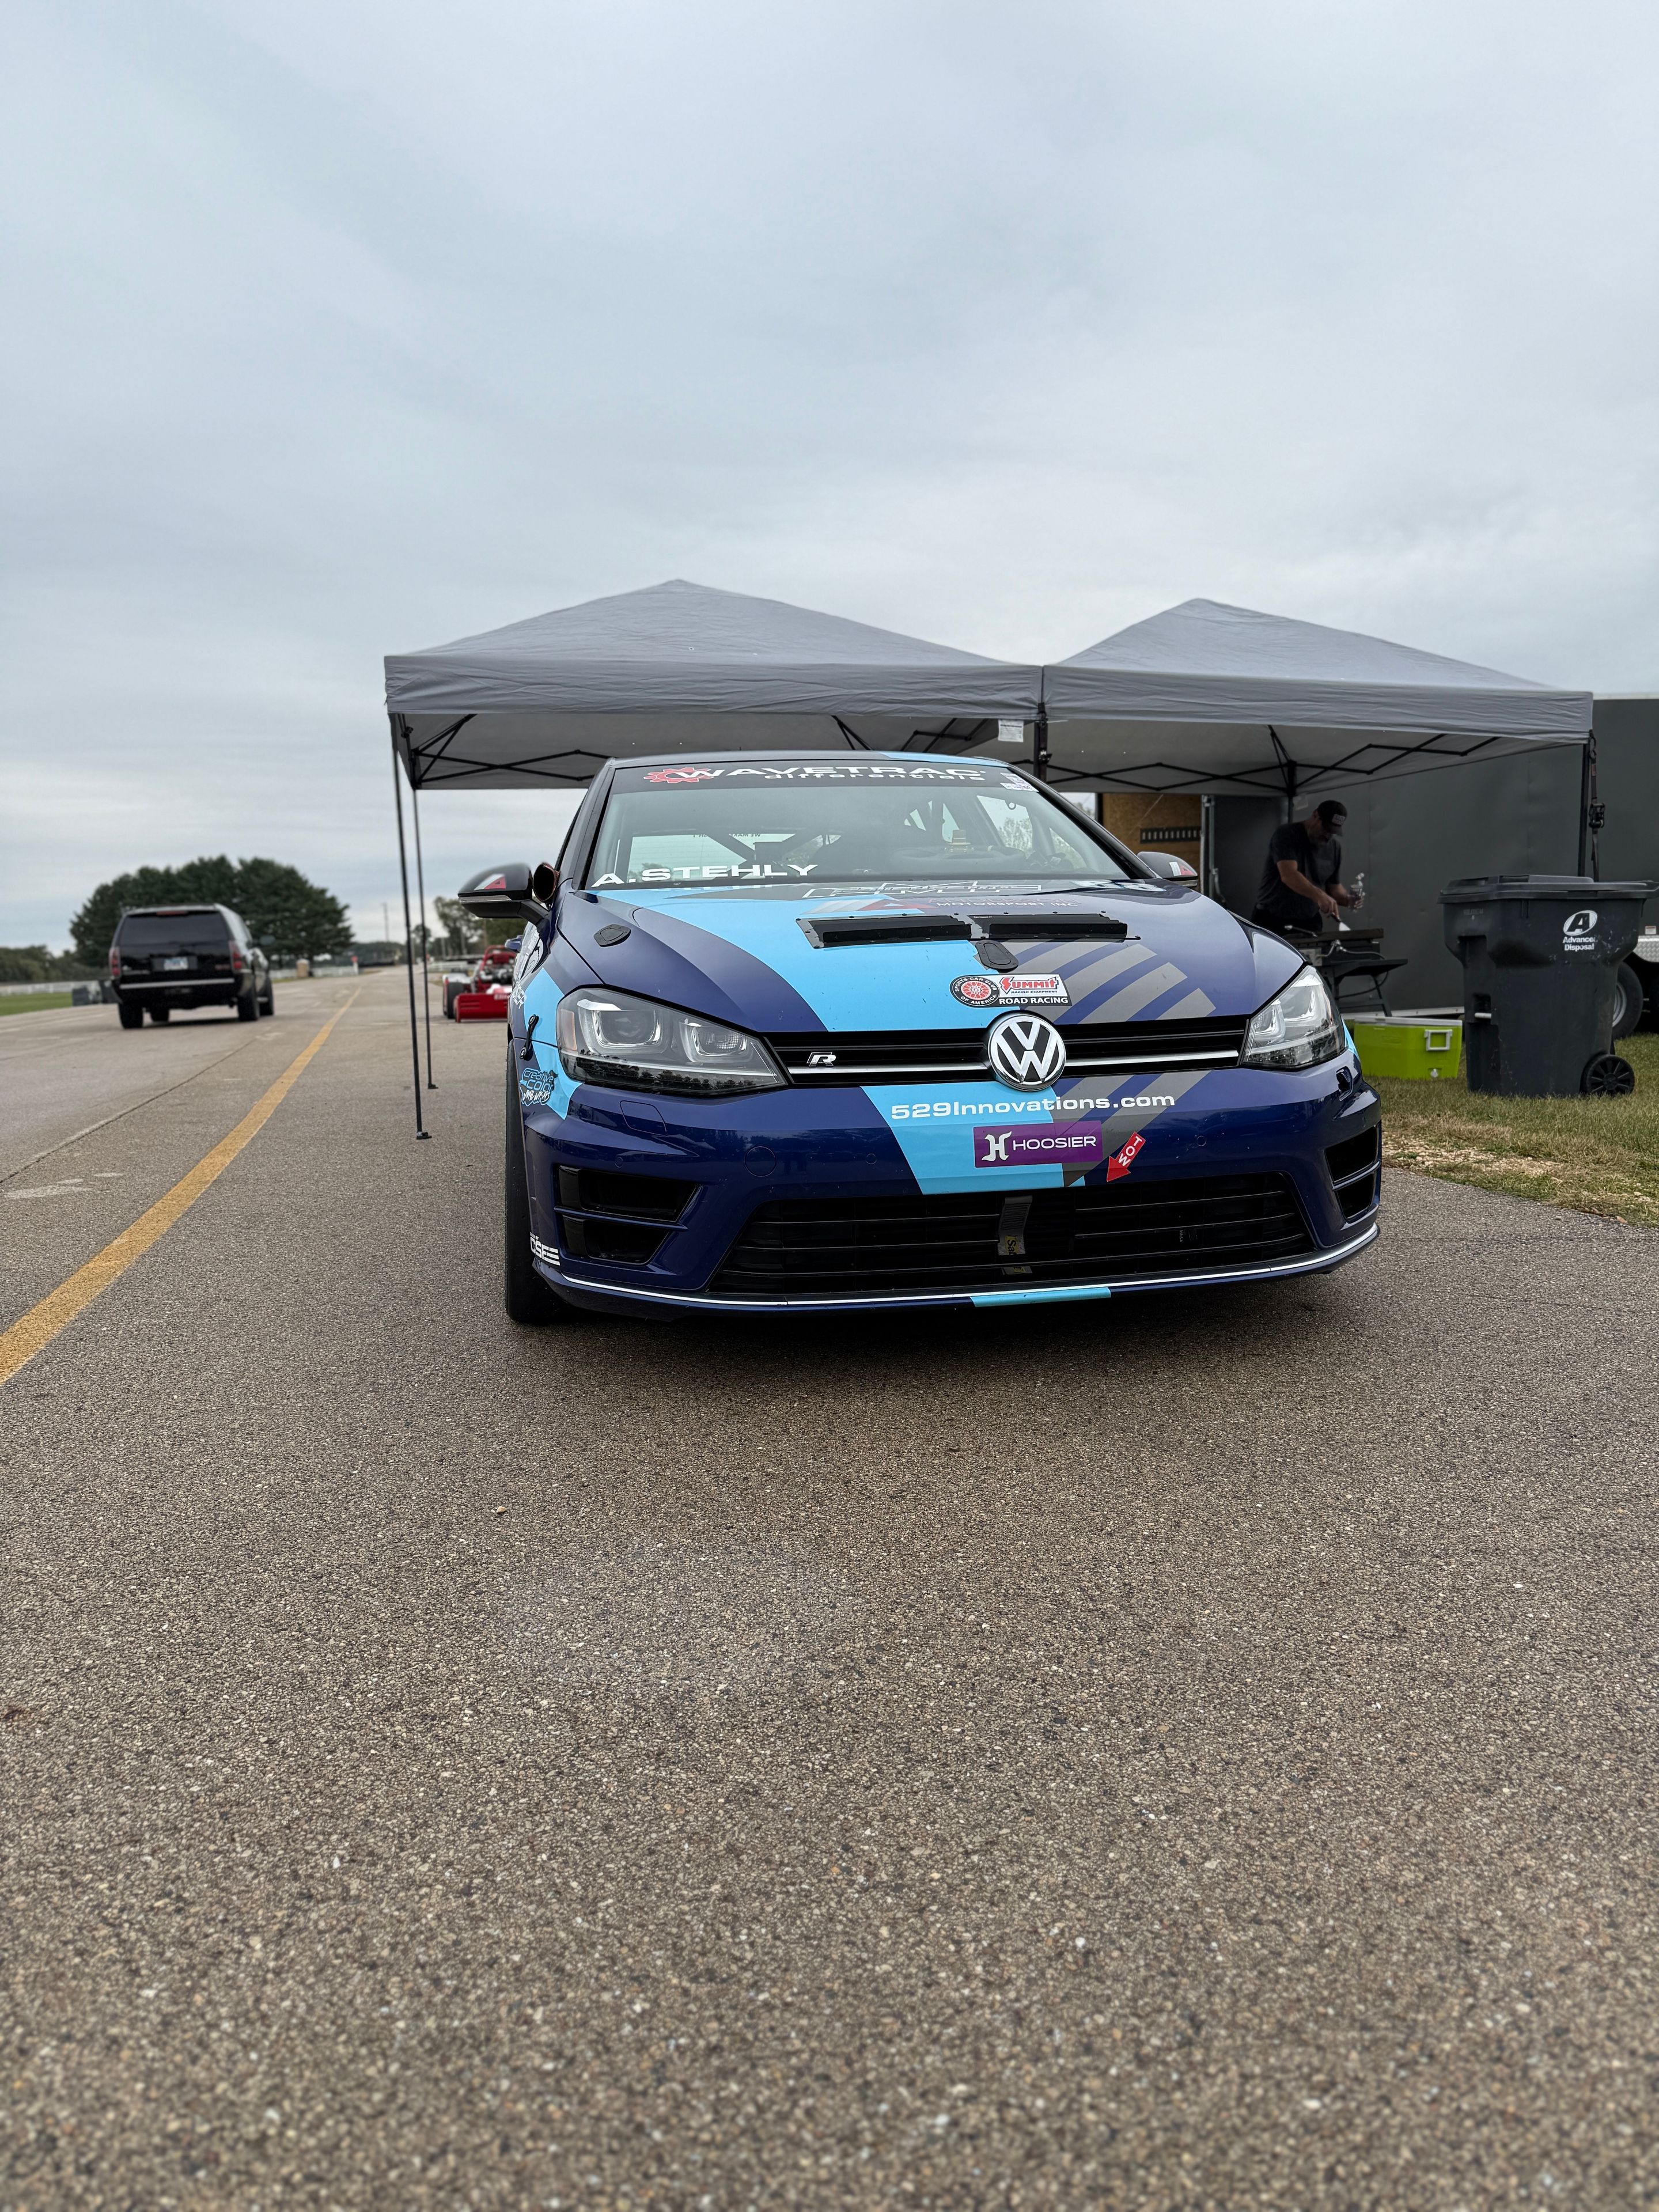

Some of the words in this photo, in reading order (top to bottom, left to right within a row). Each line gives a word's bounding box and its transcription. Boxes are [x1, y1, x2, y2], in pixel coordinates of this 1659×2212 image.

[675, 767, 982, 778] WAVETRAC
[1564, 944, 1594, 952] Disposal
[955, 977, 968, 992] SPORTS
[984, 979, 997, 991] CLUB
[971, 994, 997, 1005] AMERICA
[807, 1052, 836, 1067] R
[891, 1095, 1175, 1120] 529Innovations.com
[1013, 1135, 1096, 1152] HOOSIER
[1118, 1135, 1143, 1167] TOW
